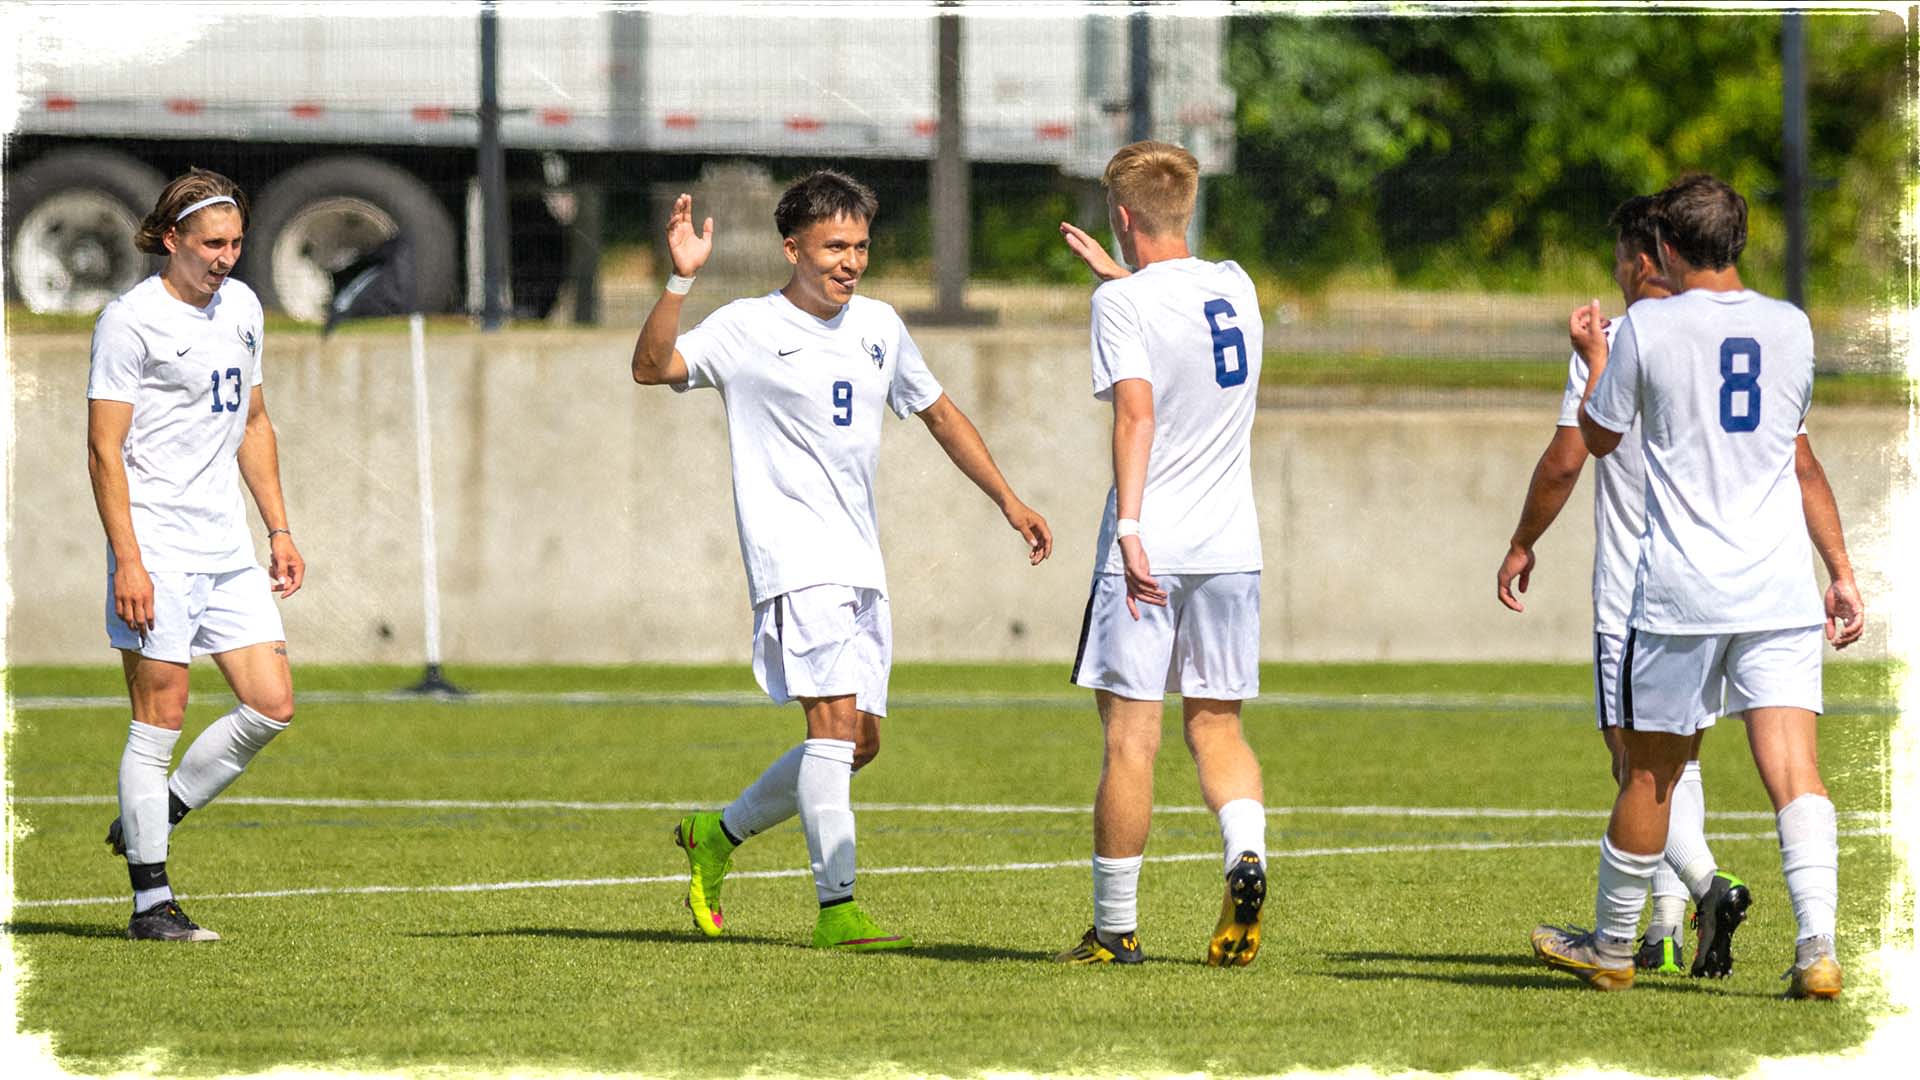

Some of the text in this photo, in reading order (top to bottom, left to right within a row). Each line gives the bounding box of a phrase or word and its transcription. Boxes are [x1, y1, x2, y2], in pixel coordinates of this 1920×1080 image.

[1203, 299, 1248, 388] 6
[210, 368, 242, 413] 13
[832, 381, 853, 426] 9
[1719, 338, 1761, 433] 8
